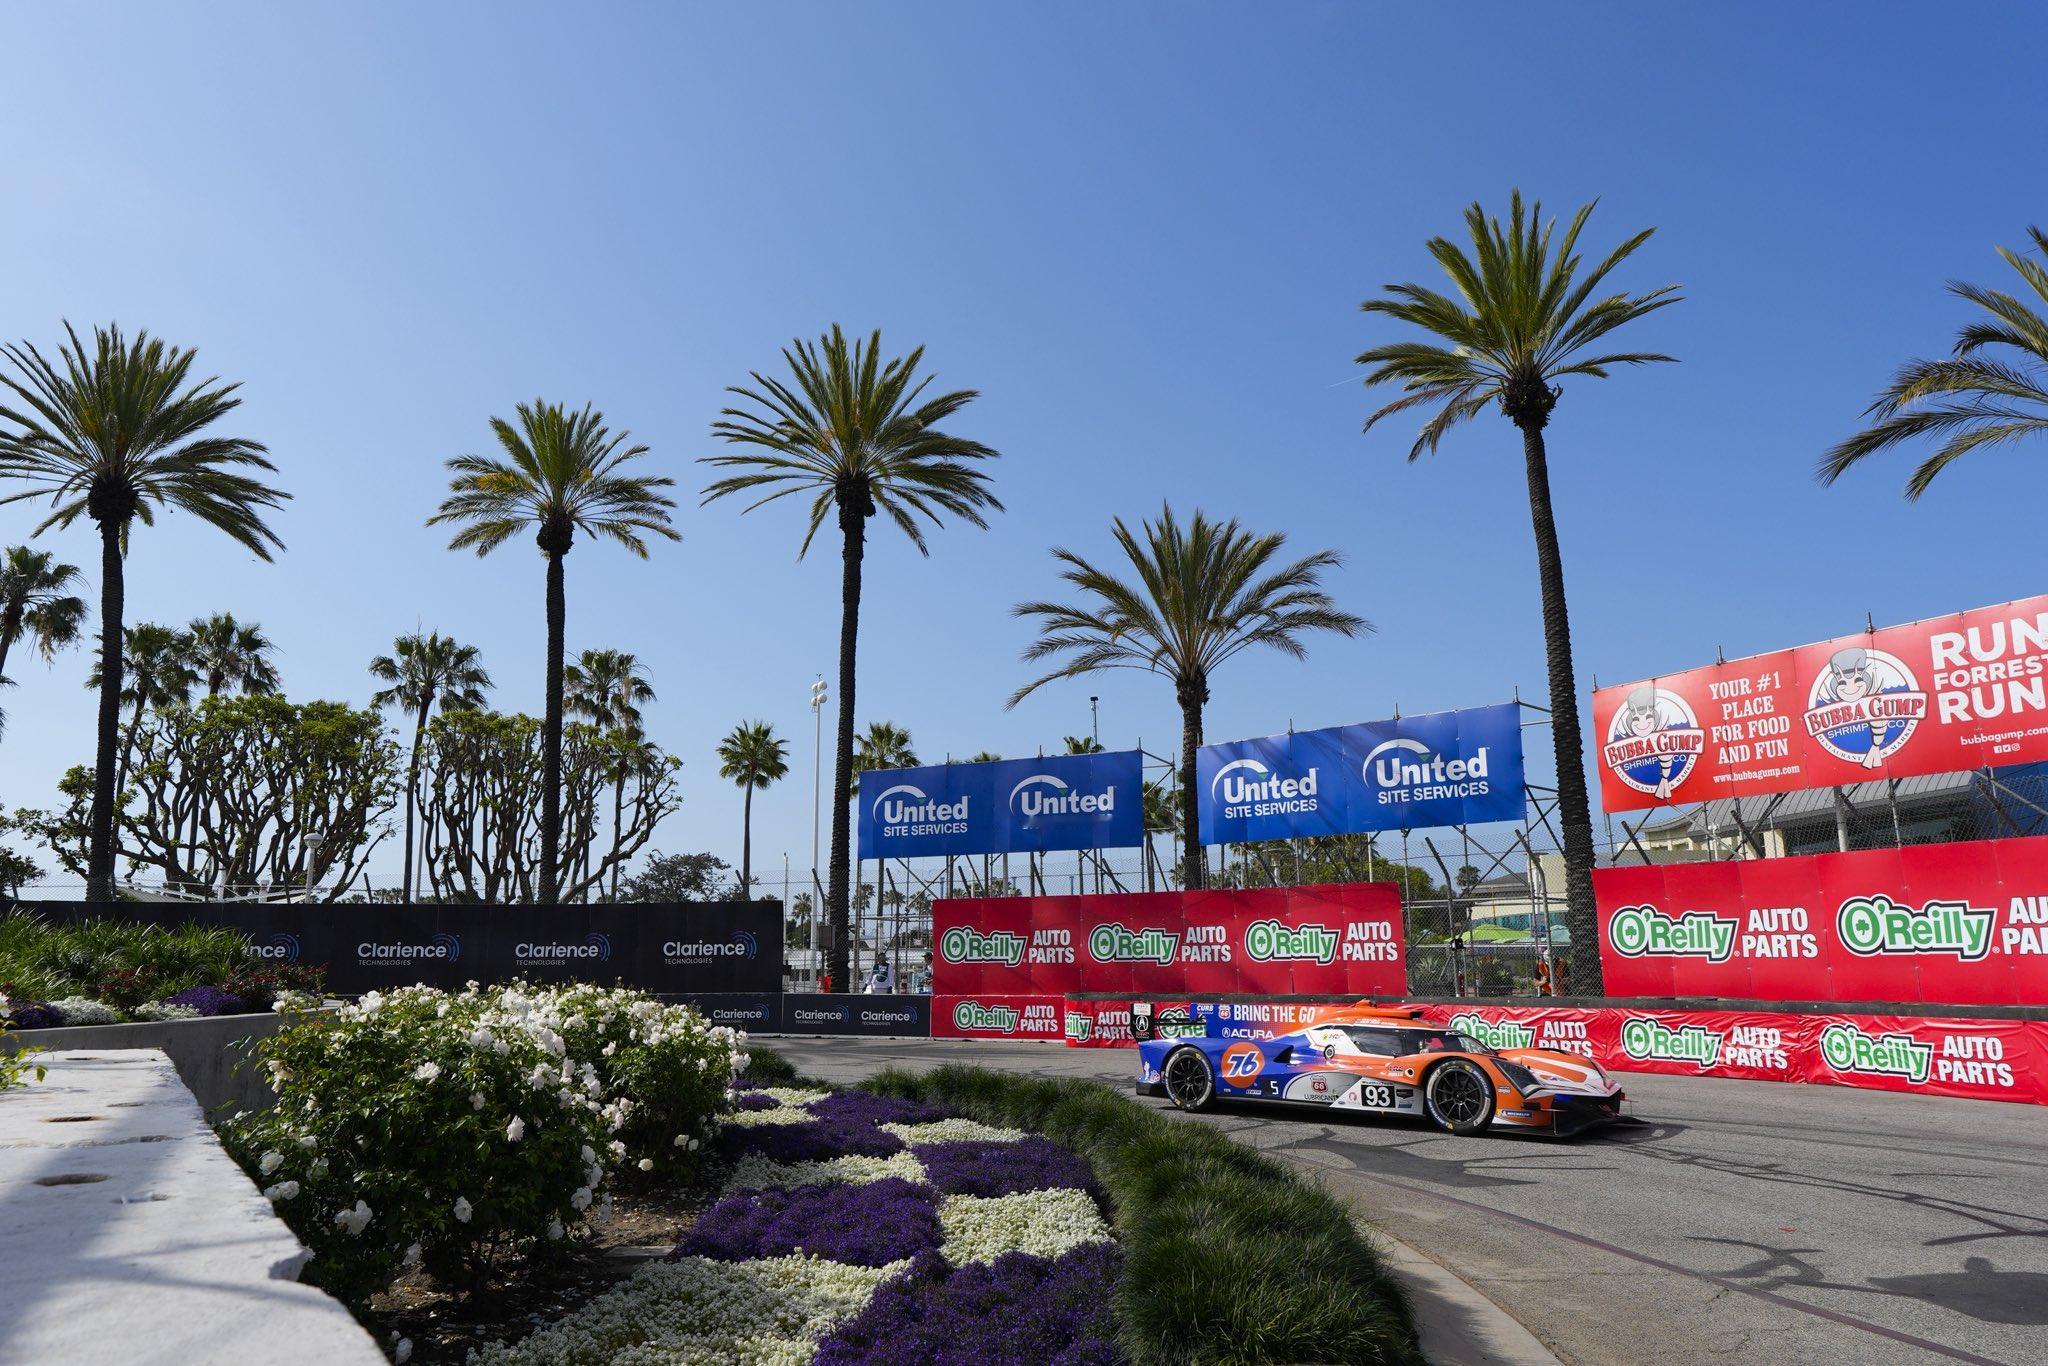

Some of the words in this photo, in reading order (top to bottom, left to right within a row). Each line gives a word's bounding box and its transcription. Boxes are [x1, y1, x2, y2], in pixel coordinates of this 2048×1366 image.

[1930, 612, 2048, 671] RUN
[1709, 677, 1752, 700] YOUR
[1757, 671, 1781, 692] #1
[1722, 696, 1774, 720] PLACE
[1937, 676, 2046, 725] RUN
[1808, 706, 1867, 734] BUBBA
[1868, 696, 1924, 718] GUMP
[1711, 724, 1744, 743] FOR
[1749, 715, 1790, 739] FOOD
[1827, 723, 1869, 739] SHRIMP
[1961, 727, 2048, 745] bubbagump.com
[1606, 738, 1654, 765] BUBBA
[1656, 732, 1703, 753] GUMP
[1718, 745, 1750, 765] AND
[1754, 738, 1789, 759] FUN
[1817, 735, 1862, 761] RESTAURANT
[1890, 722, 1916, 752] MARKET
[1376, 748, 1488, 788] United
[1615, 767, 1654, 792] RESTAURANT
[1676, 756, 1695, 783] MARKET
[1623, 756, 1658, 771] SHRIMP
[1713, 764, 1800, 784] www.bubbagump.com
[1223, 768, 1318, 804] United
[1378, 790, 1410, 805] SITE
[1413, 782, 1489, 801] SERVICES
[884, 795, 968, 824] United
[1021, 785, 1115, 816] United
[1224, 805, 1252, 819] SITE
[1254, 799, 1318, 816] SERVICES
[884, 825, 908, 838] SITE
[911, 822, 968, 836] SERVICES
[1346, 922, 1392, 940] AUTO
[1748, 908, 1808, 932] AUTO
[1843, 901, 1987, 953] O'Reilly
[1033, 930, 1070, 946] AUTO
[1091, 924, 1177, 962] O'Reilly
[1186, 926, 1226, 943] AUTO
[1249, 921, 1335, 961] O'Reilly
[1614, 910, 1732, 956] O'Reilly
[2001, 927, 2048, 955] PA
[357, 942, 446, 958] Clarience
[515, 942, 598, 958] Clarience
[663, 940, 745, 956] Clarience
[943, 928, 1026, 963] O'Reilly
[1028, 948, 1075, 964] PARTS
[1181, 945, 1231, 962] PARTS
[1342, 942, 1398, 961] PARTS
[1742, 934, 1818, 958] PARTS
[713, 1009, 762, 1019] Clarience
[794, 1009, 842, 1020] Clarience
[861, 1010, 910, 1022] Clarience
[955, 1003, 1018, 1032] O'Reilly
[1024, 1005, 1055, 1018] AUTO
[1098, 1011, 1131, 1026] AUTO
[1220, 1009, 1229, 1017] 66
[1233, 1004, 1270, 1021] BRING
[1272, 1005, 1296, 1022] THE
[1299, 1006, 1315, 1023] GO
[1020, 1019, 1058, 1032] PARTS
[1230, 1028, 1275, 1039] ACURA
[1452, 1016, 1531, 1050] O'Reilly
[1543, 1021, 1587, 1039] AUTO
[1625, 1021, 1718, 1063] O'Reilly
[1732, 1026, 1781, 1049] AUTO
[1943, 1035, 2003, 1061] AUTO
[1226, 1050, 1260, 1077] 76
[1725, 1047, 1788, 1070] PARTS
[1825, 1028, 1926, 1077] O'Reilly
[1937, 1060, 2014, 1087] PARTS
[1270, 1080, 1279, 1095] 5
[1314, 1082, 1325, 1090] 66
[1365, 1086, 1391, 1107] 93
